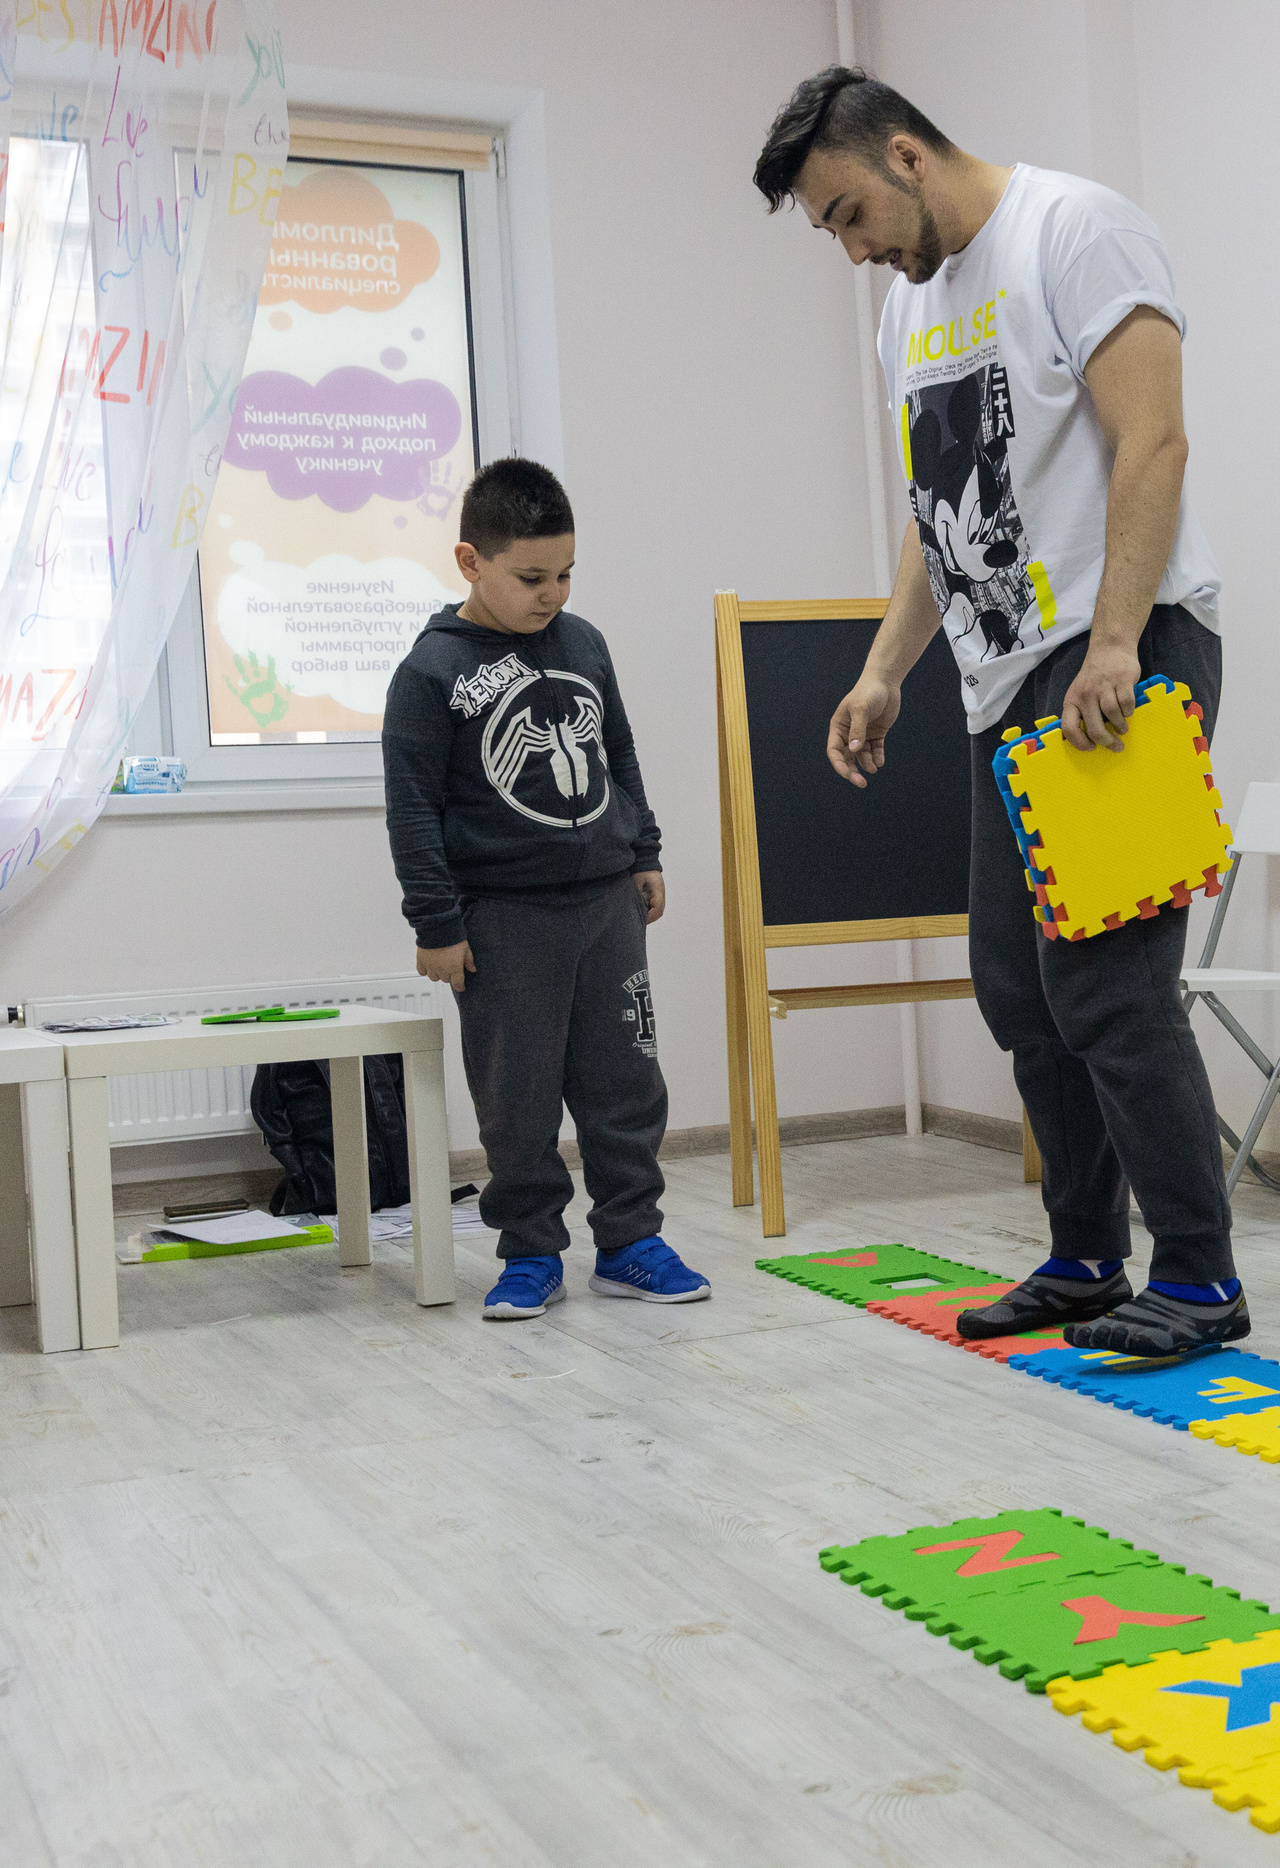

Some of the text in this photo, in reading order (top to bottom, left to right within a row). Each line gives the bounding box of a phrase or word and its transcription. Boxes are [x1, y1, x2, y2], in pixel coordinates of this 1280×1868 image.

[906, 300, 996, 368] MOUSE
[450, 653, 537, 719] VENOM
[1061, 1596, 1206, 1645] Y
